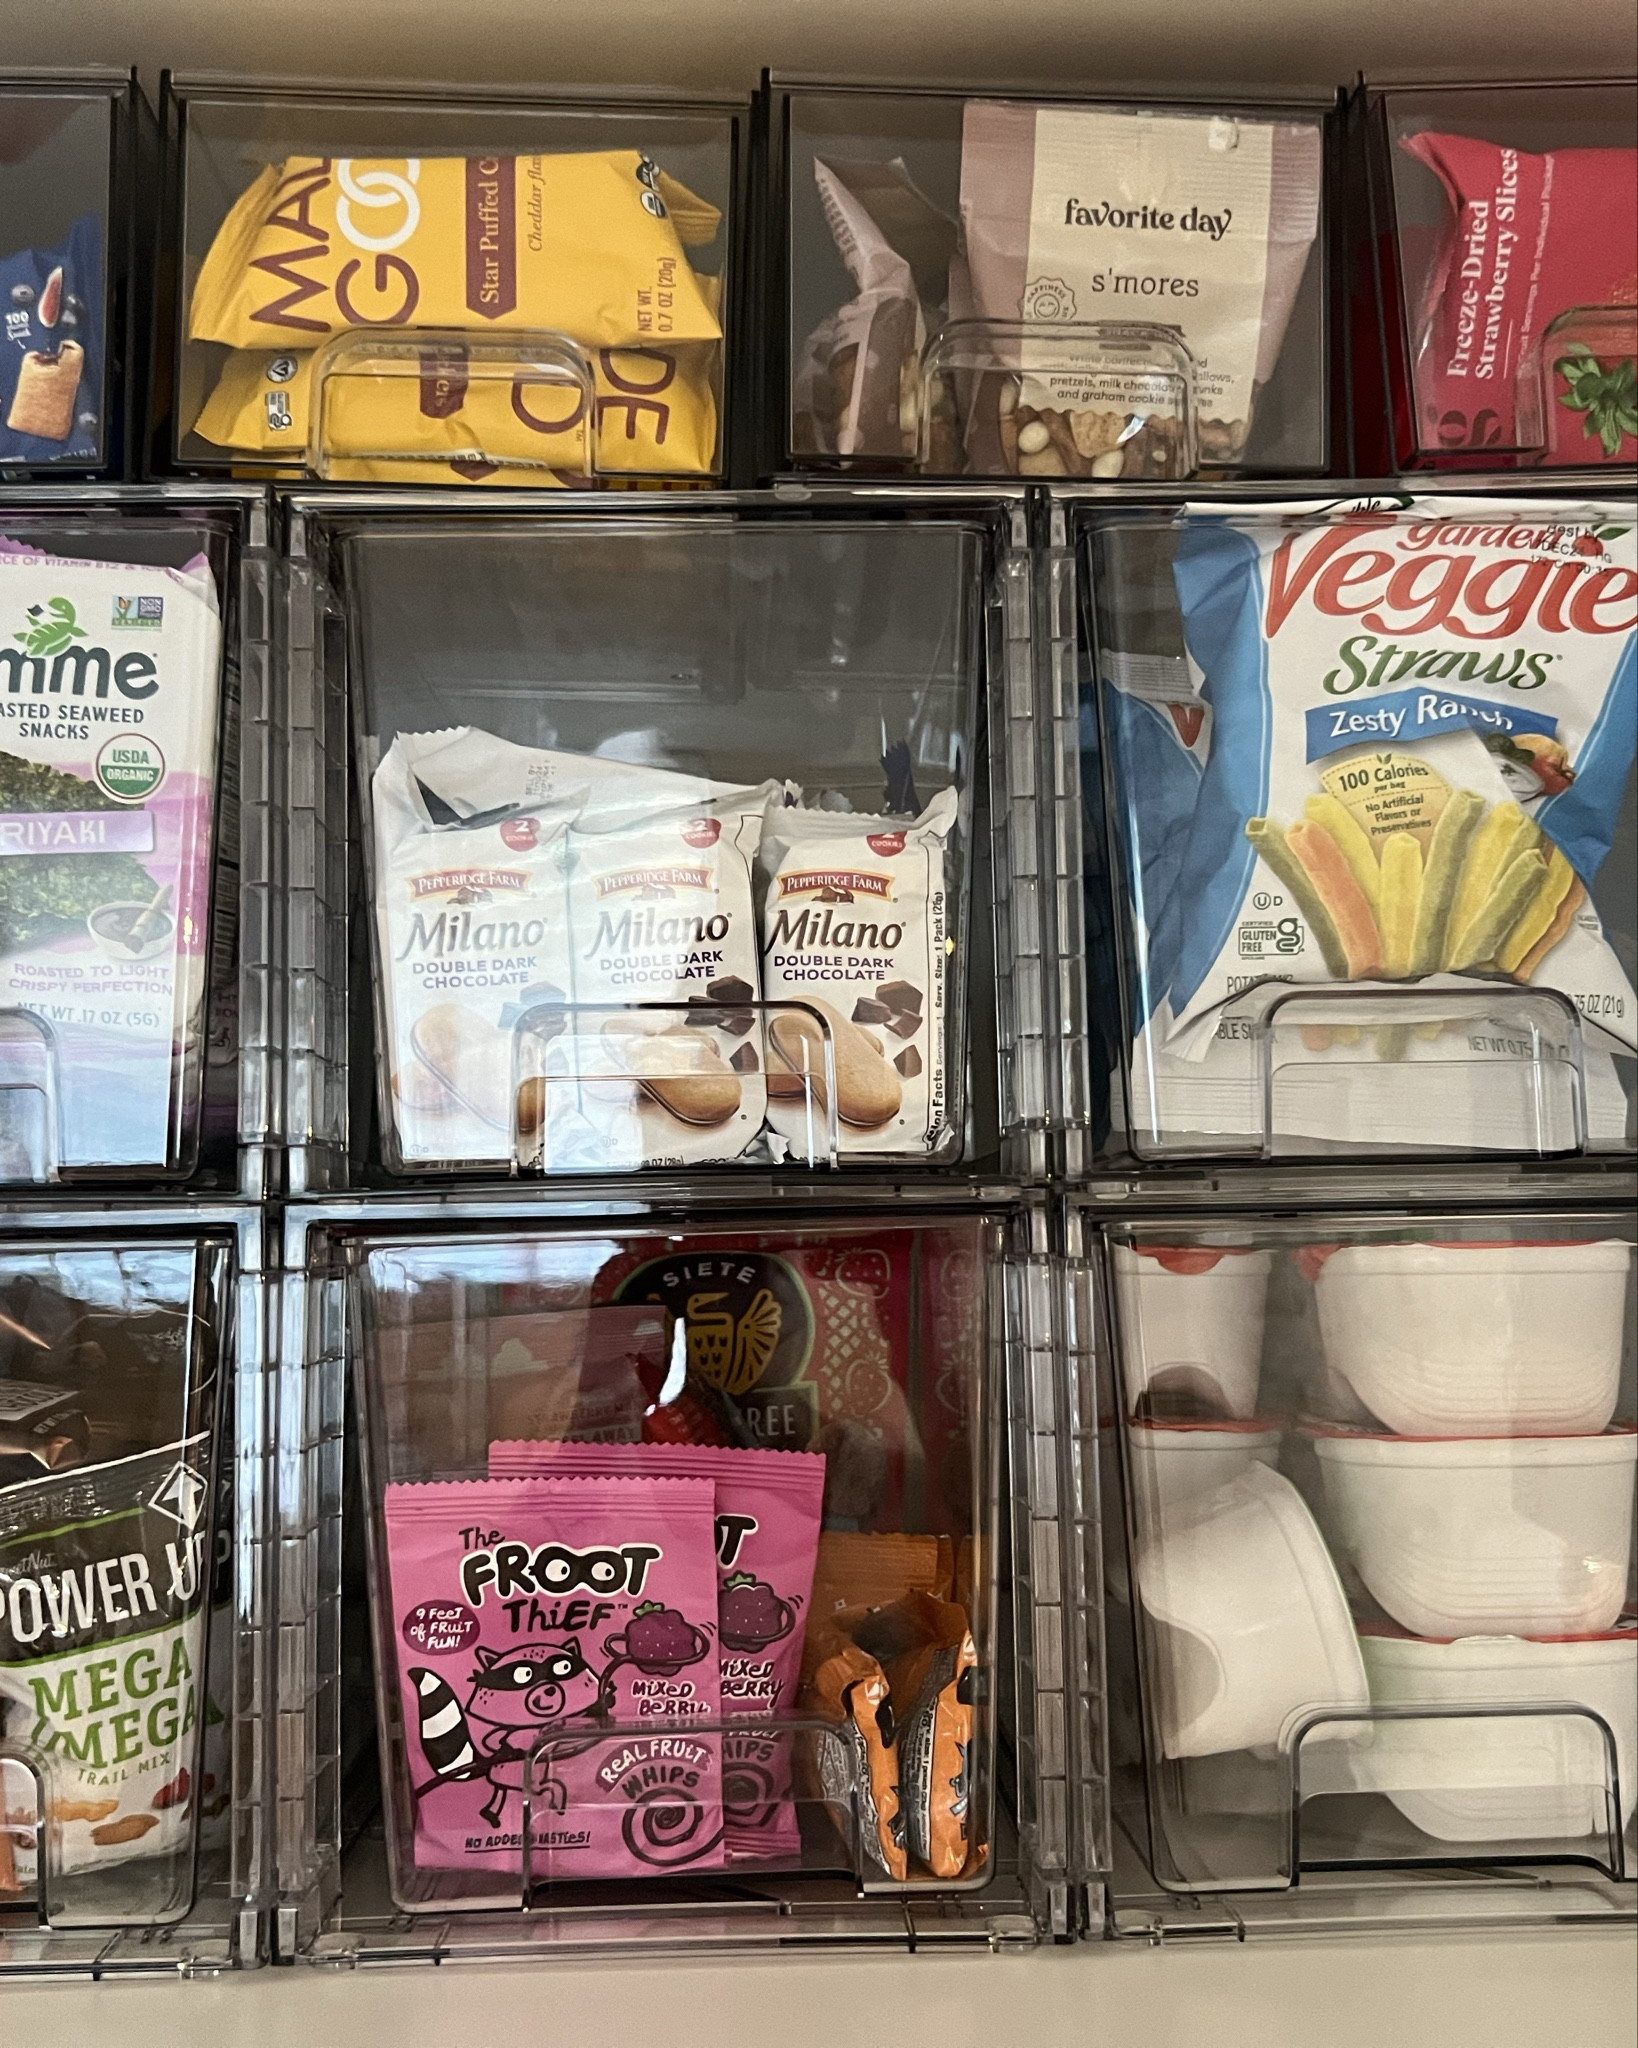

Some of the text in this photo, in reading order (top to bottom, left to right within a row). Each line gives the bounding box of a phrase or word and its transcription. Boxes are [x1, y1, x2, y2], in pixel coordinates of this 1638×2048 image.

[477, 181, 499, 251] Puffed
[528, 184, 543, 252] Cheddar
[1064, 198, 1232, 242] favorite day
[1475, 149, 1519, 380] Strawberry Slices
[479, 257, 499, 304] Star
[1091, 267, 1199, 297] s'mores
[1447, 200, 1489, 377] Freeze-Dried
[6, 311, 30, 326] 100
[1050, 375, 1096, 389] pretzels,
[1100, 378, 1121, 389] milk
[1057, 389, 1080, 400] and
[1082, 391, 1126, 404] graham
[1265, 522, 1638, 640] Veggie
[1322, 635, 1555, 696] Straws
[58, 704, 145, 724] SEAWEED
[1329, 705, 1408, 740] Zesty
[18, 721, 90, 741] SNACKS
[112, 748, 150, 766] USDA
[105, 767, 155, 783] ORGANIC
[1338, 763, 1430, 792] 100 Calories
[1373, 780, 1406, 794] per bag
[1365, 793, 1425, 814] No Artificial
[513, 819, 530, 833] 2
[1374, 808, 1422, 823] Flavors or
[1370, 819, 1433, 836] Preservatives
[418, 869, 521, 891] PEPPERIDGE FARM
[603, 869, 703, 891] PEPPERIDGE FARM
[786, 874, 883, 893] PEPPERIDGE FARM
[396, 911, 546, 963] Milano
[585, 910, 730, 958] Milano
[765, 909, 903, 958] Milano
[933, 918, 943, 943] Pack
[1241, 930, 1278, 941] GLUTEN
[1241, 941, 1263, 953] FREE
[14, 962, 170, 980] ROASTED TO LIGHT
[412, 955, 538, 975] DOUBLE DARK
[600, 950, 724, 972] DOUBLE DARK
[773, 955, 895, 969] DOUBLE DARK
[422, 970, 530, 990] CHOCOLATE
[610, 965, 716, 985] CHOCOLATE
[782, 969, 886, 982] CHOCOLATE
[9, 977, 173, 996] CRISPY PERFECTION
[52, 1005, 74, 1022] WT
[100, 1011, 122, 1025] OZ
[126, 1011, 160, 1029] (5G)
[1587, 994, 1625, 1019] OZ (21g)
[932, 1068, 944, 1108] Facts
[662, 1261, 757, 1289] SIETE
[458, 1527, 506, 1550] The
[459, 1541, 663, 1608] FROOT
[416, 1607, 426, 1620] 9
[410, 1622, 427, 1643] of
[28, 1636, 194, 1722] MEGA
[77, 1751, 172, 1786] TRAIL MIX
[621, 1764, 701, 1800] WHIPS
[464, 1837, 483, 1849] NO
